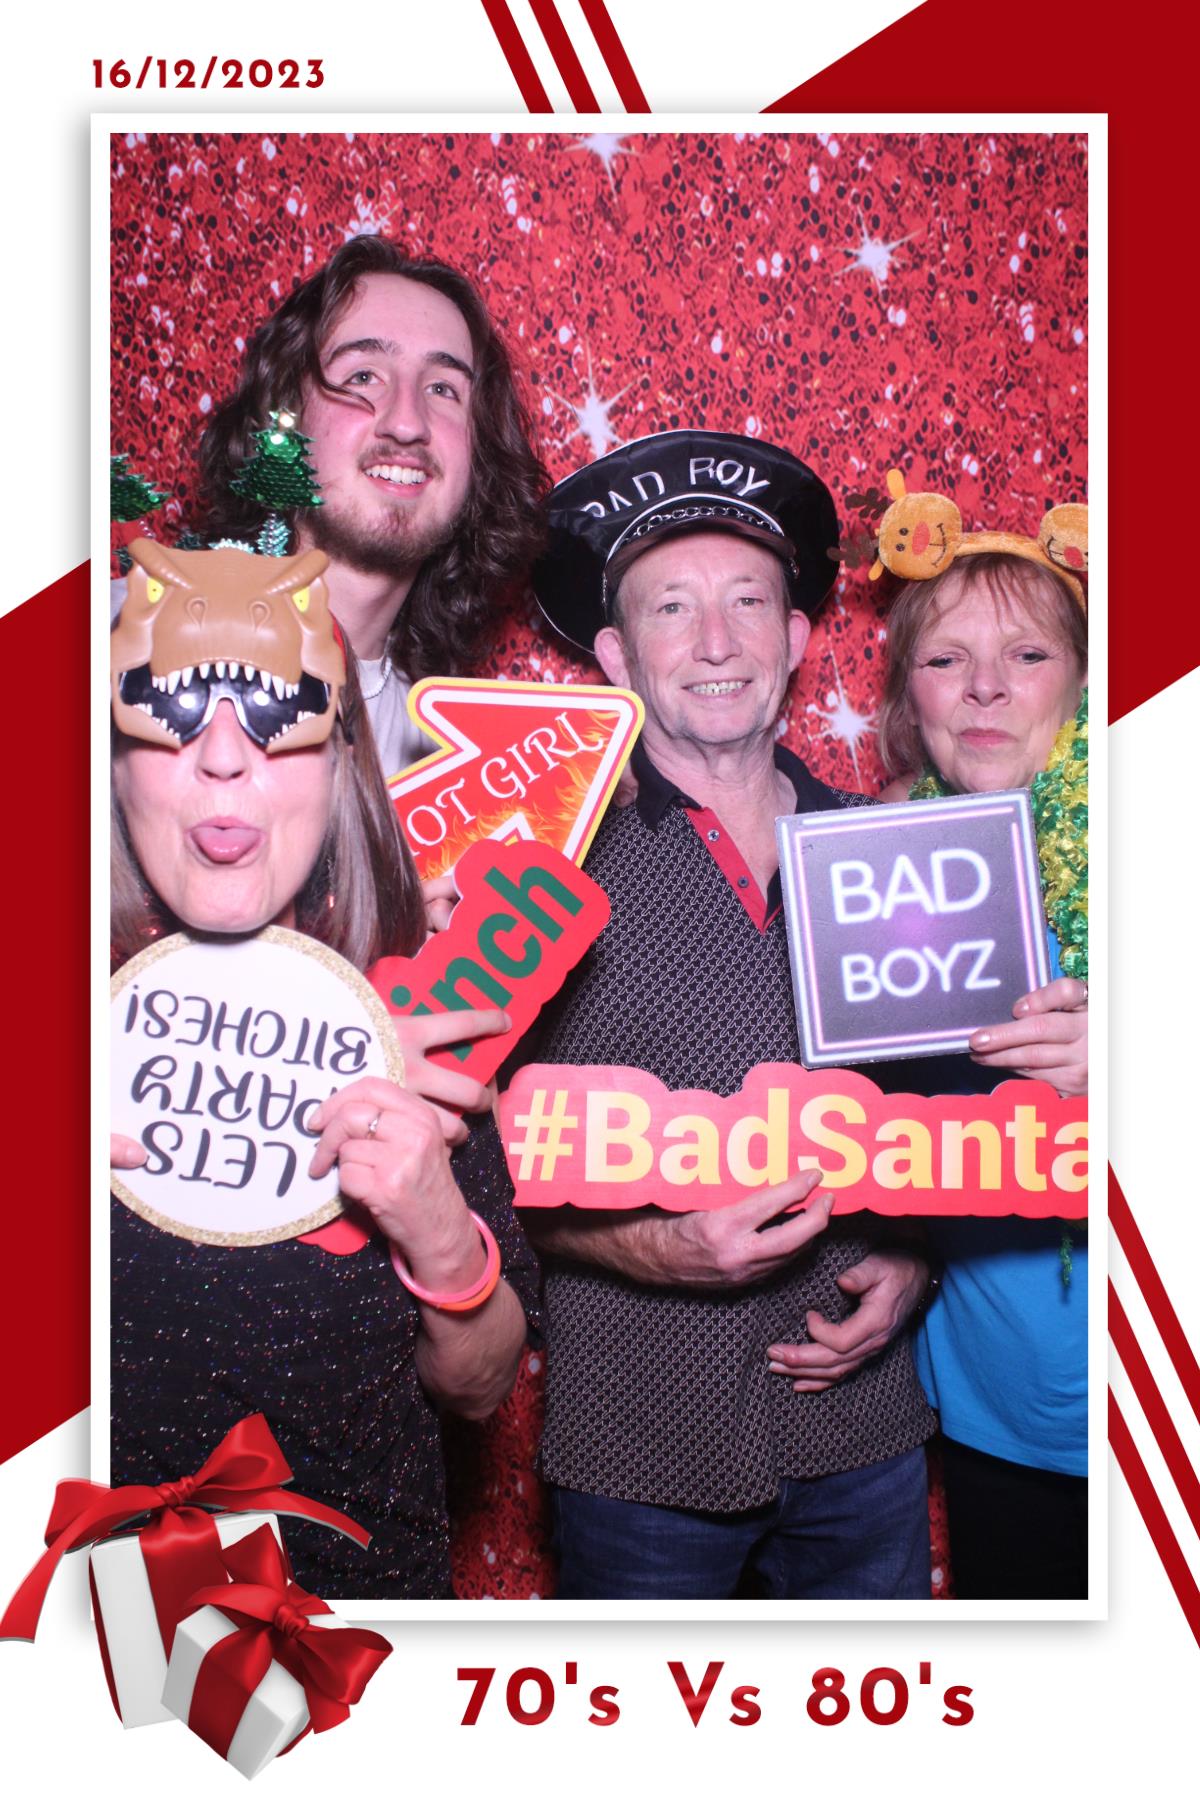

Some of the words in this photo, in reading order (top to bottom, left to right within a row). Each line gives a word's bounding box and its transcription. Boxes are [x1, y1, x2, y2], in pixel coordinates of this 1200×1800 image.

[411, 778, 477, 857] OT
[480, 711, 605, 800] GIRL
[829, 847, 991, 925] BAD
[841, 938, 1001, 1003] BOYZ
[124, 984, 372, 1075] BITCHES!
[141, 1120, 297, 1198] LETS
